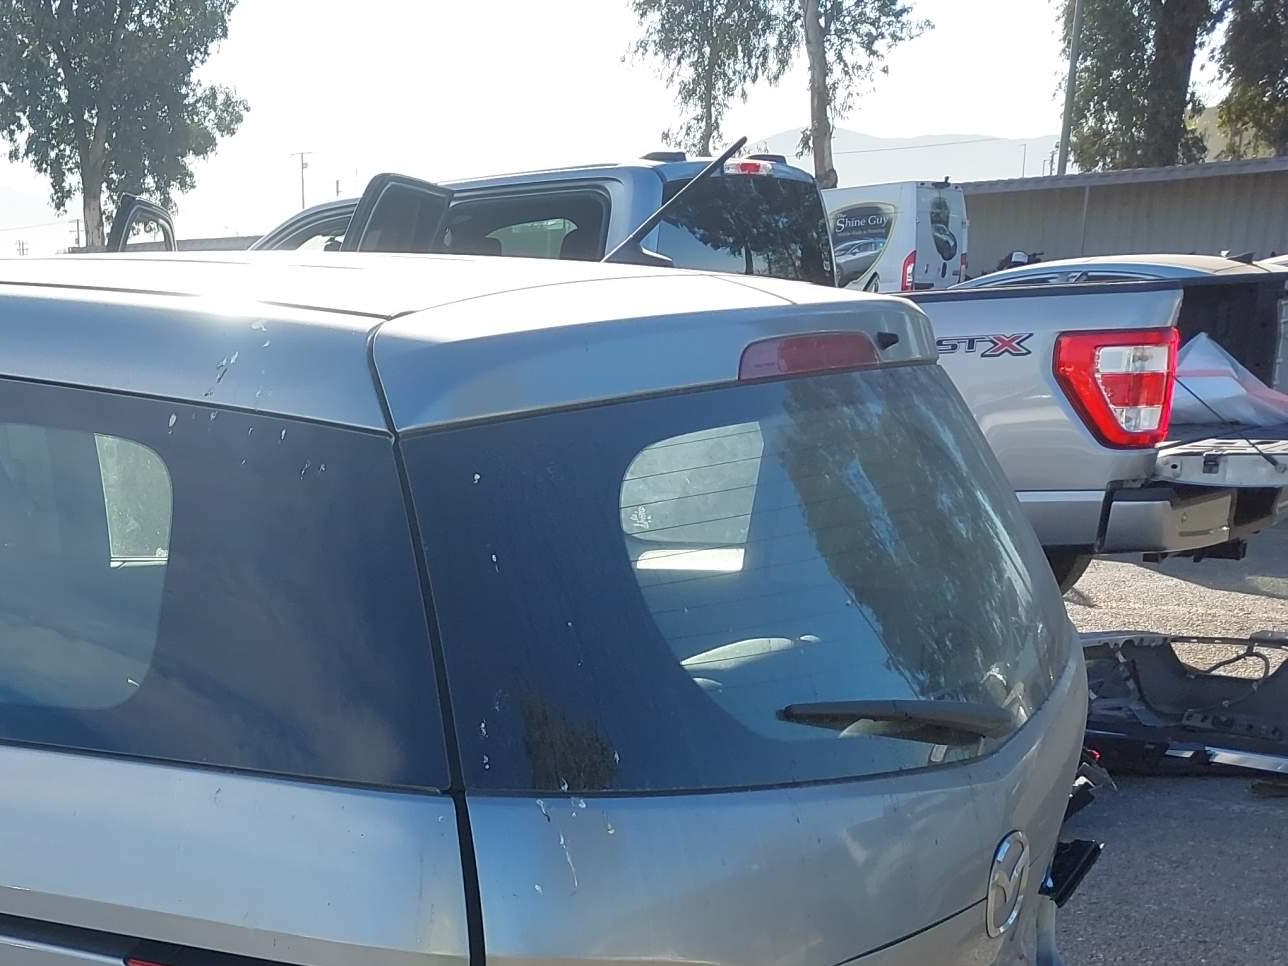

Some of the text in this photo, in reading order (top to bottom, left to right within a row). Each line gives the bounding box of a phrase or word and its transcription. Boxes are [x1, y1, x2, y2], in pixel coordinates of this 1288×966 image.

[835, 216, 866, 233] Shine
[867, 215, 889, 227] Guy
[935, 332, 1034, 358] STX
